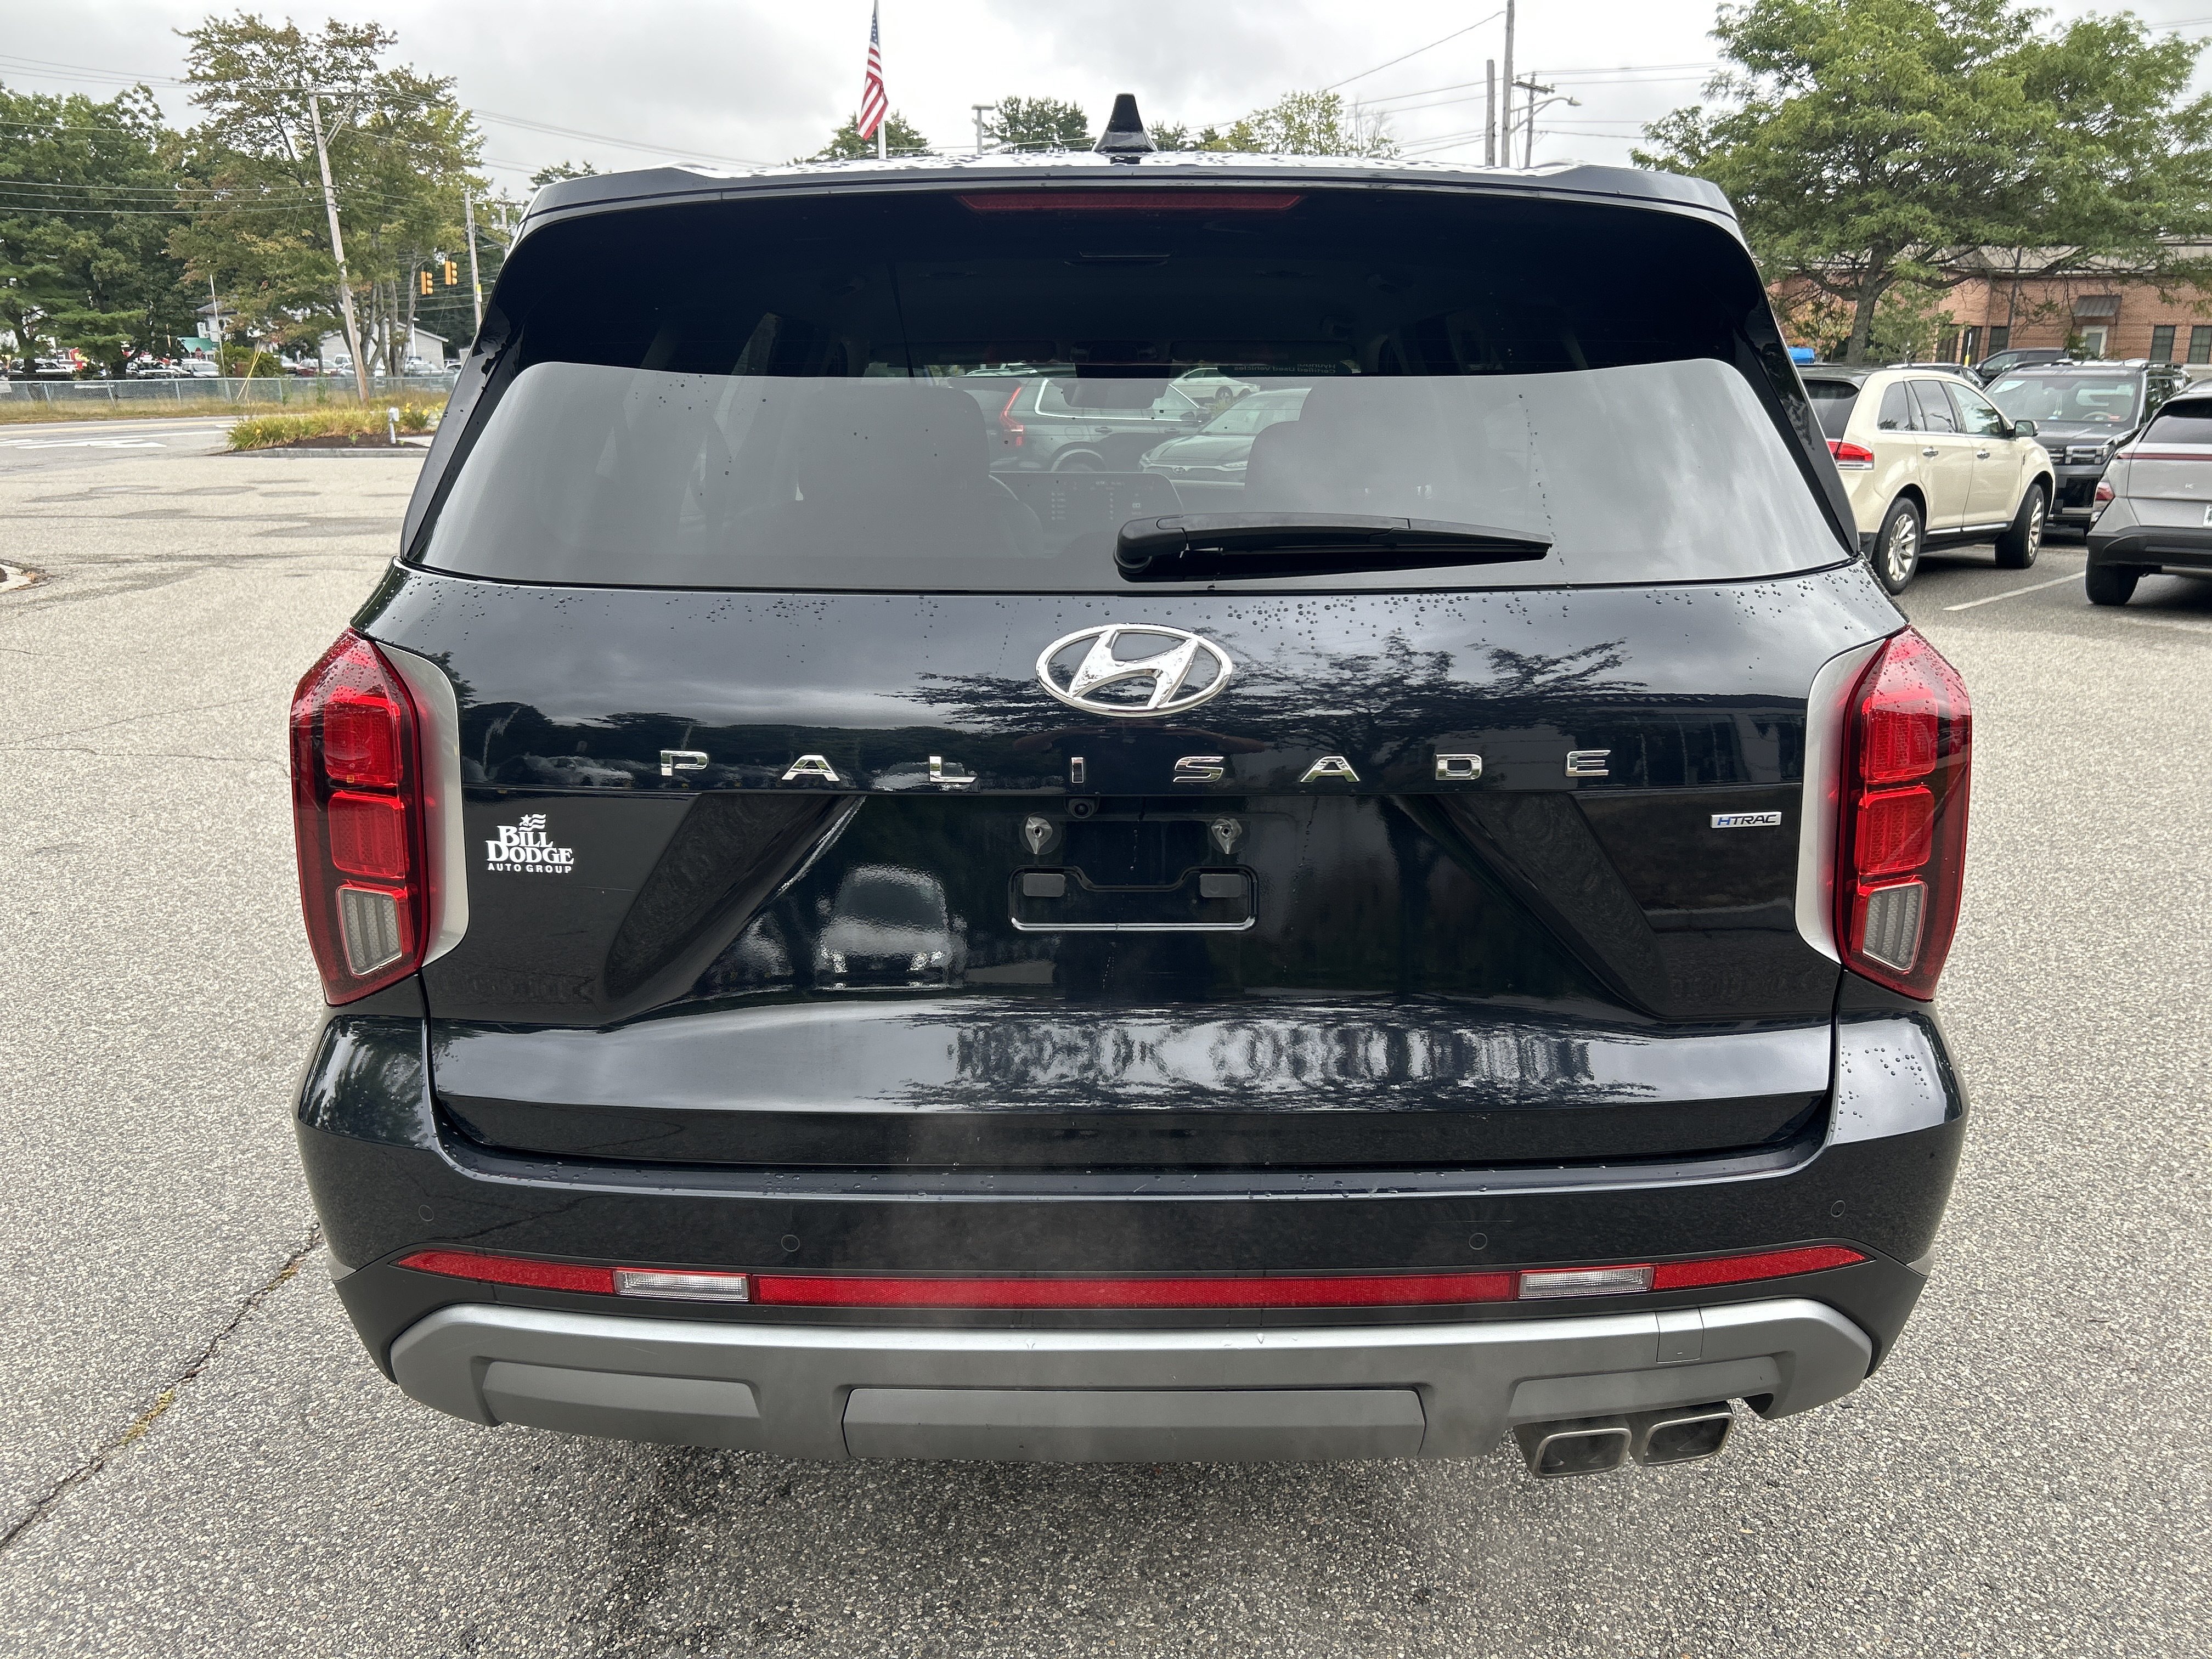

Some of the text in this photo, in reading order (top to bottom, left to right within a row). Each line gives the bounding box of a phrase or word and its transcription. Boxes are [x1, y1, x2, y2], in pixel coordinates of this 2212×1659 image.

[660, 749, 1611, 785] PALISADE
[1717, 815, 1776, 825] HTRAC
[497, 825, 554, 848] BILL
[485, 840, 574, 864] DODGE
[488, 863, 572, 874] AUTO GROUP
